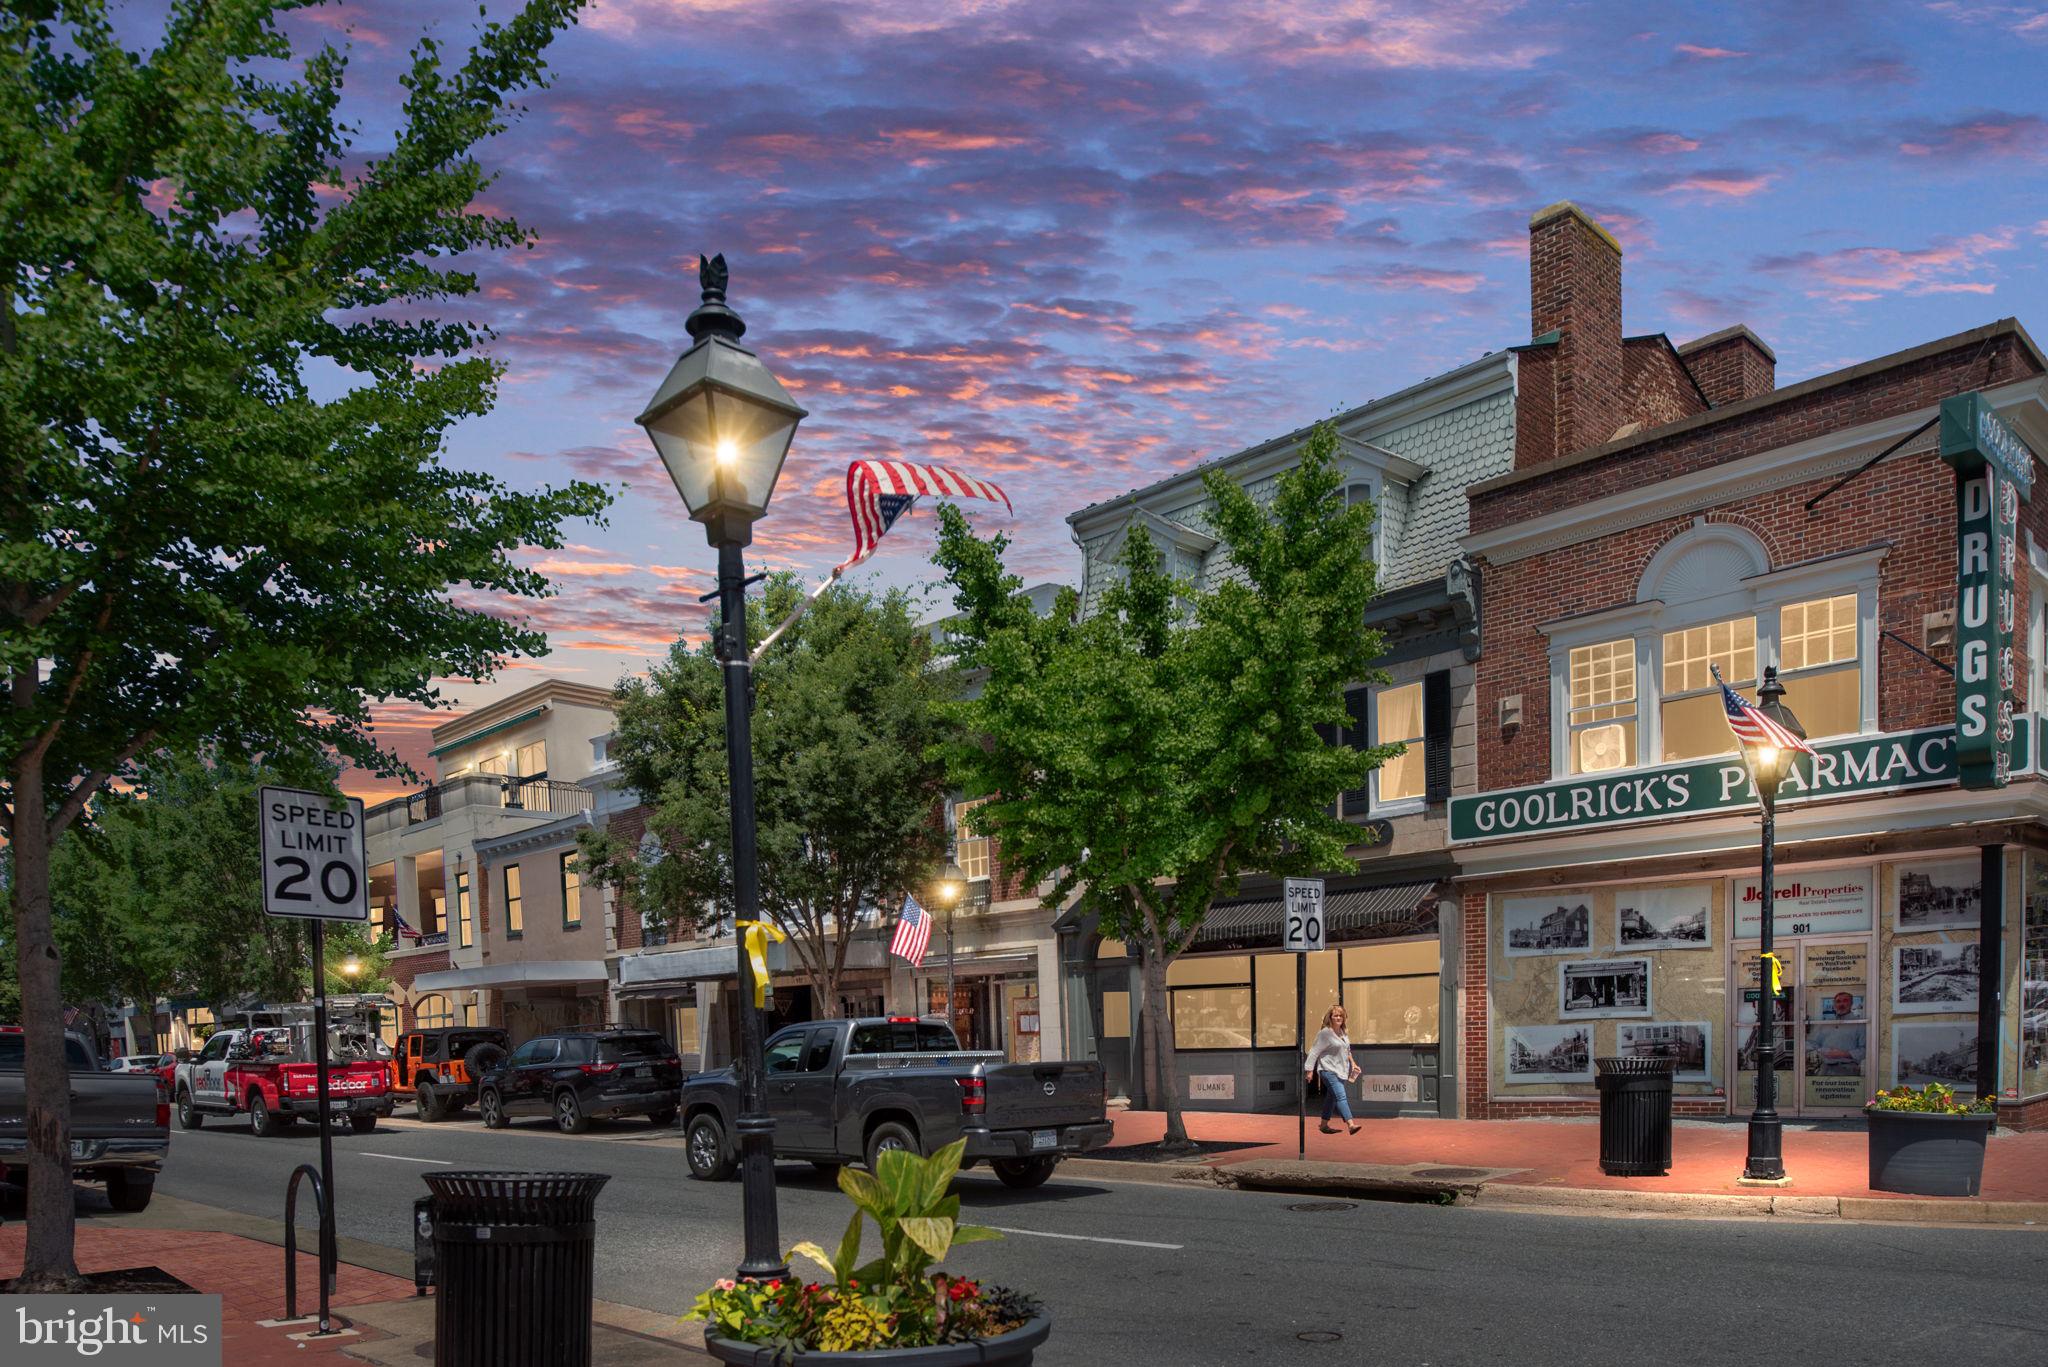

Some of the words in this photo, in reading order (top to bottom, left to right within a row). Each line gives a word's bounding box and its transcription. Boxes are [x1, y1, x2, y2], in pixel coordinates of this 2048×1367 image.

[1962, 478, 1989, 738] DRUGS
[1475, 773, 1690, 832] GOOLRICK'S
[272, 803, 355, 829] SPEED
[281, 830, 347, 854] LIMIT
[273, 856, 358, 904] 20
[1288, 887, 1320, 899] SPEED
[1803, 883, 1864, 899] Properties
[1291, 901, 1318, 913] LIMIT
[1288, 916, 1320, 943] 20
[1792, 923, 1811, 934] 901
[1197, 1083, 1226, 1092] ULMANS
[1372, 1083, 1407, 1093] ULMANS
